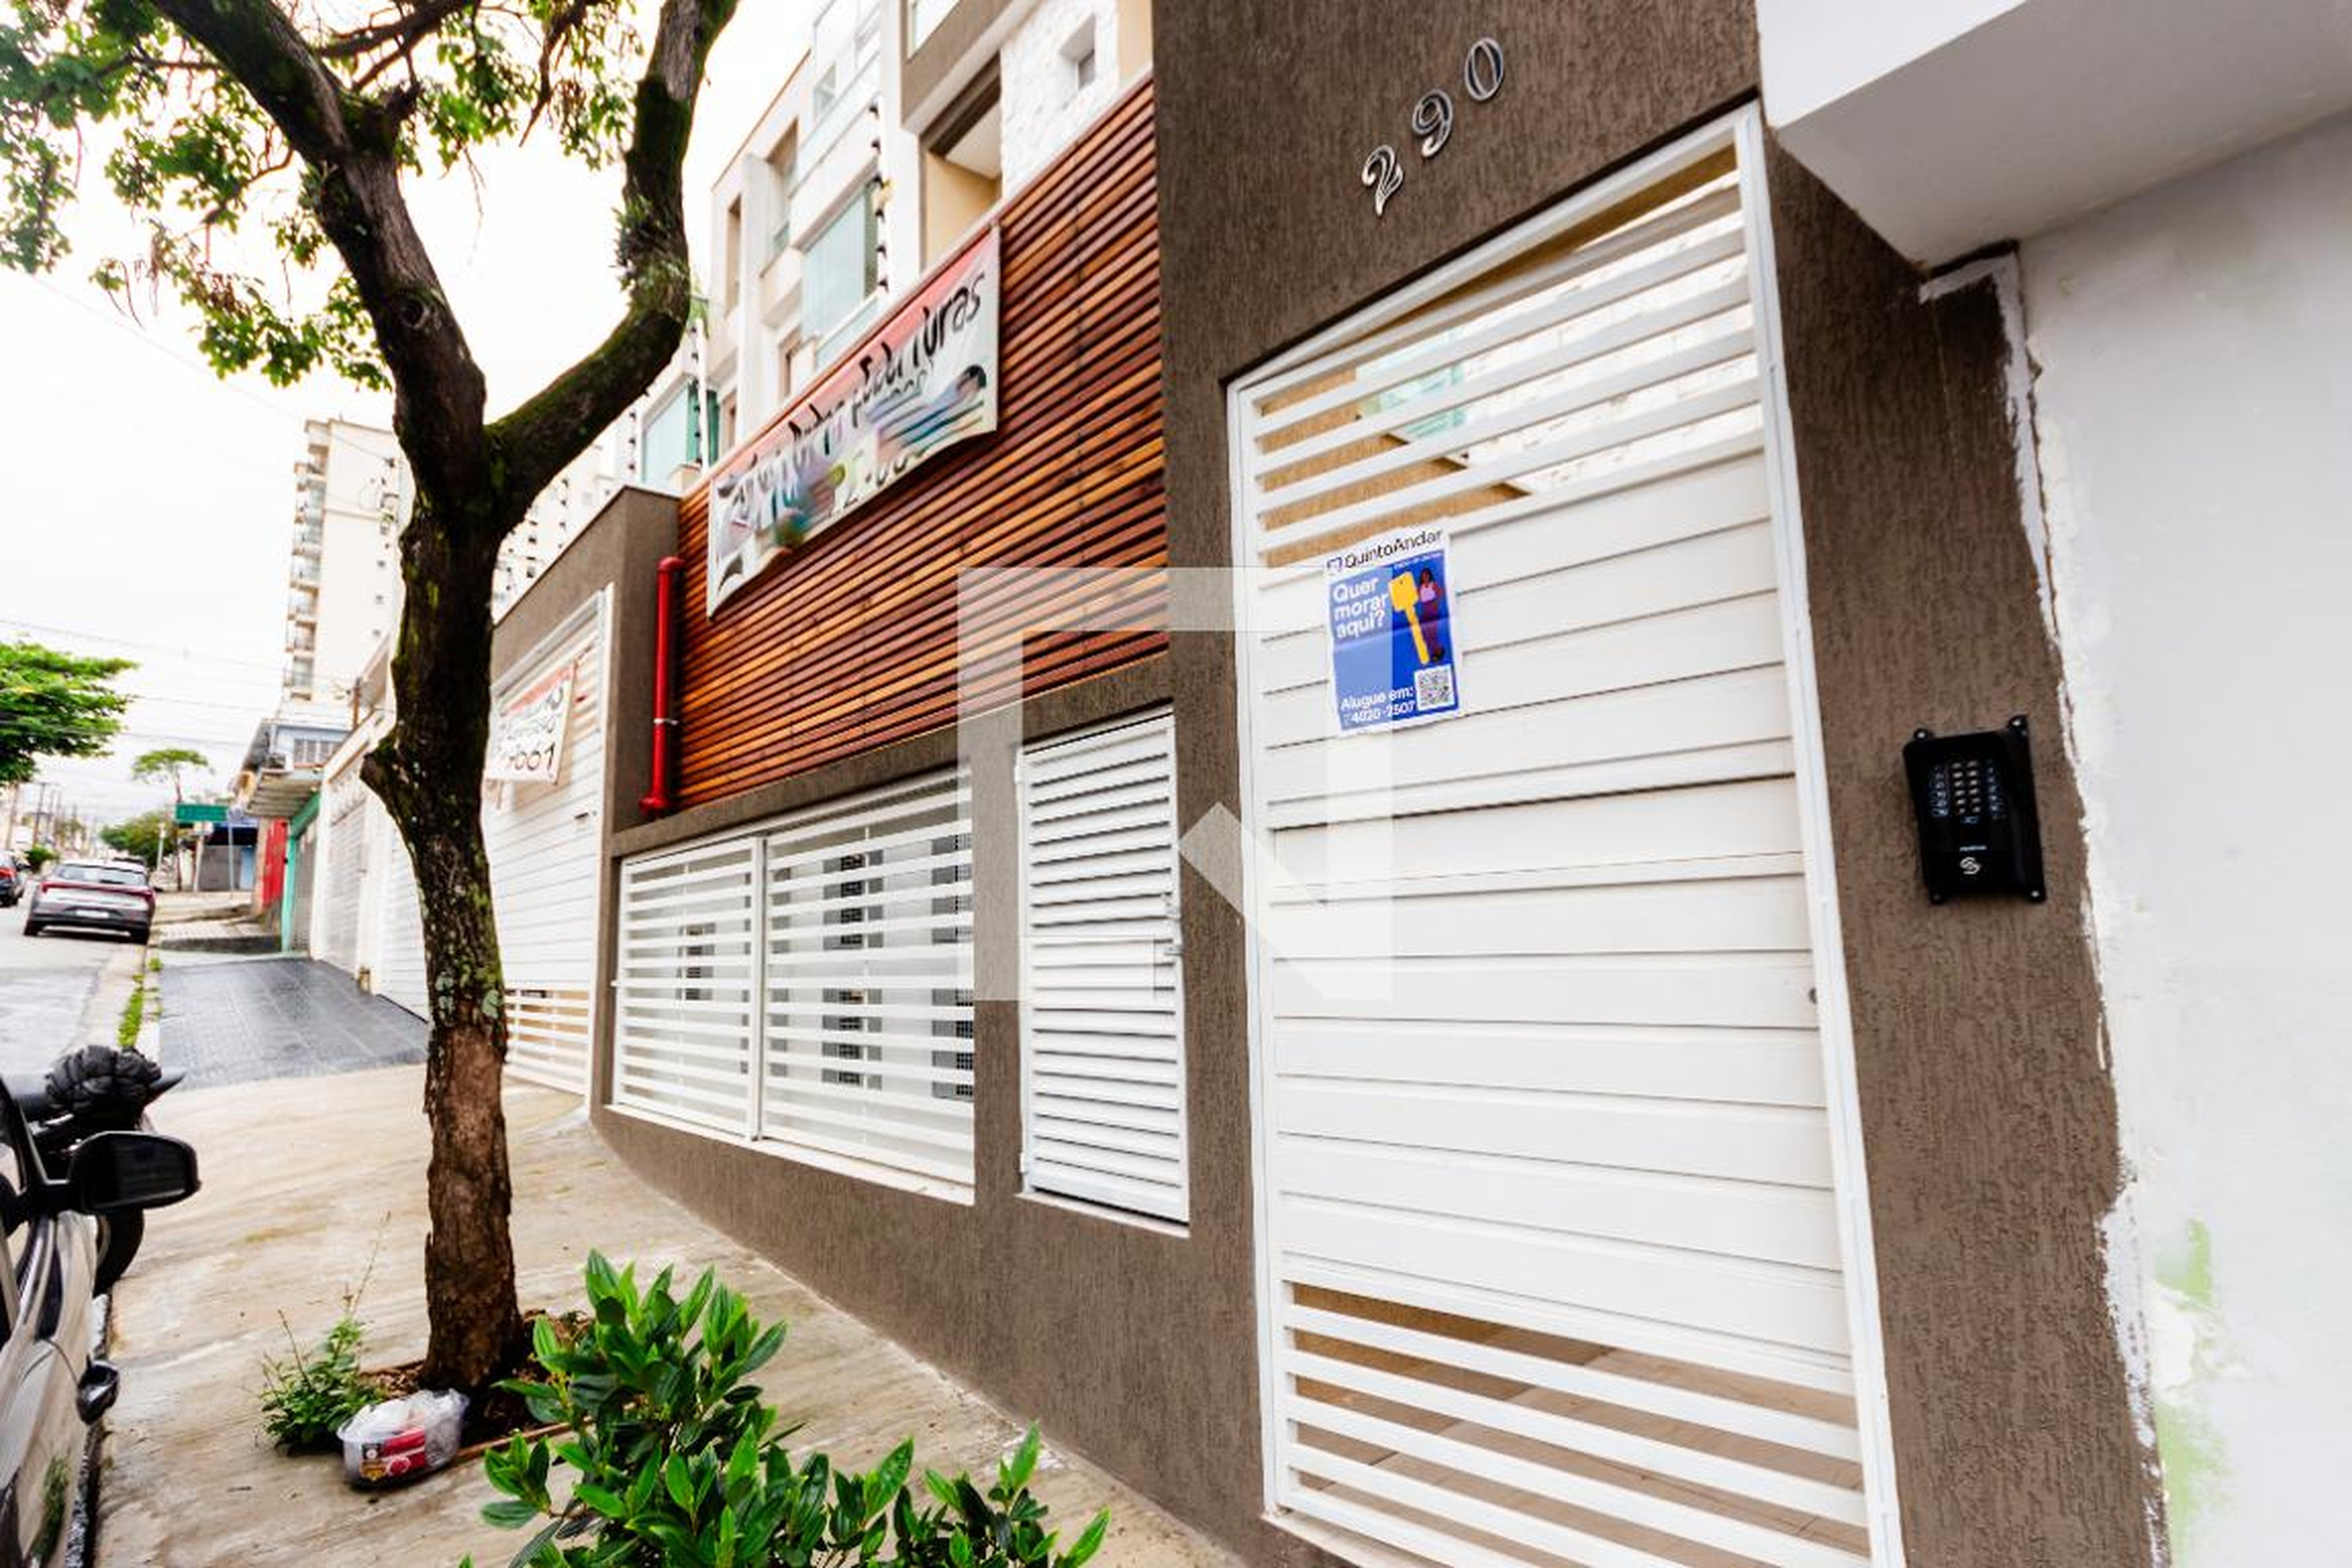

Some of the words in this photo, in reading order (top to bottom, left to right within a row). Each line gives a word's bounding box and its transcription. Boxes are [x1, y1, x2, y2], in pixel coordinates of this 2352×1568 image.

[1362, 37, 1504, 216] 290
[1345, 530, 1442, 568] QuintoAndar
[1334, 578, 1378, 602] Quer
[1335, 594, 1389, 621] morar
[1336, 610, 1385, 638] aqui?
[1341, 692, 1386, 711] Alugue
[1389, 687, 1414, 701] em:
